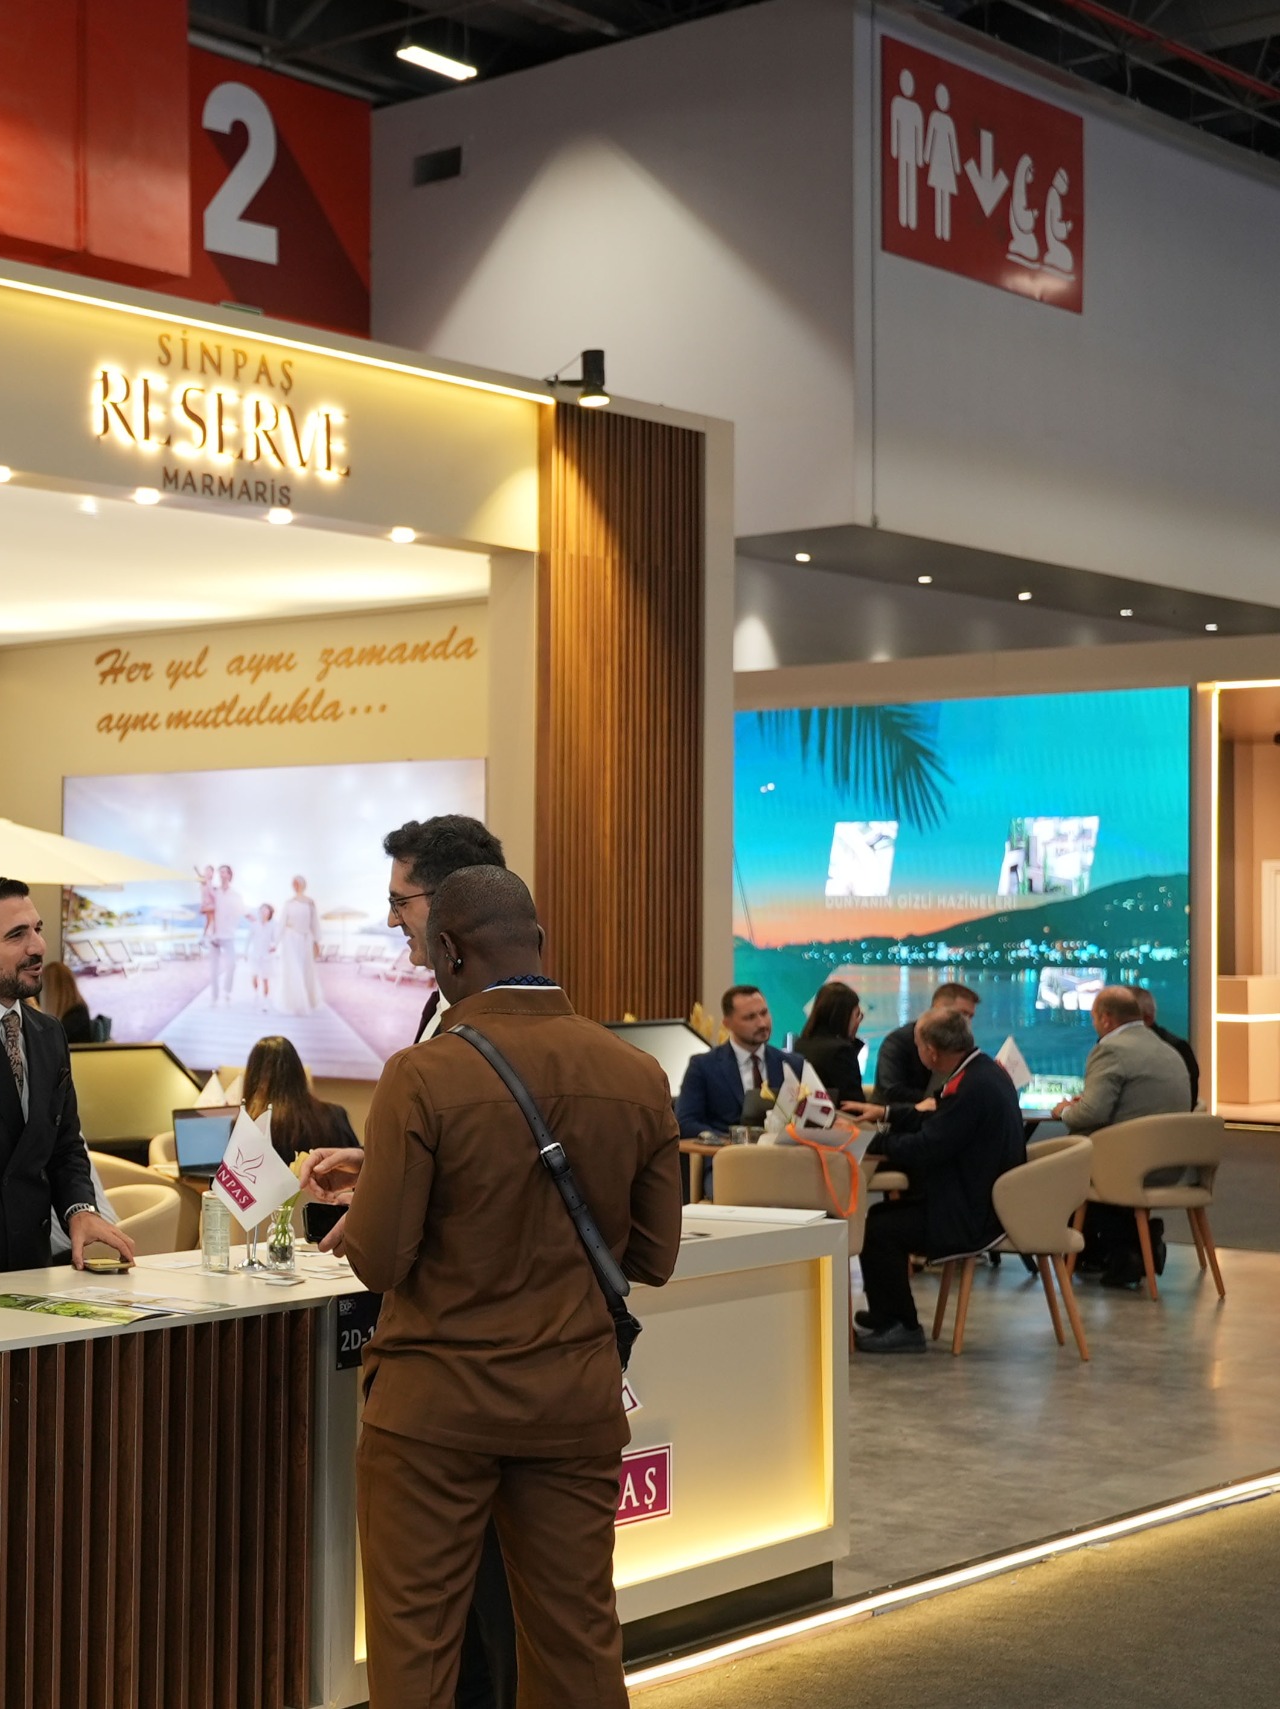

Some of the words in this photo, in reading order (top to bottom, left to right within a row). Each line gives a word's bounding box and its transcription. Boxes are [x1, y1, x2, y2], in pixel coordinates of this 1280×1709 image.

[201, 80, 278, 265] 2
[156, 330, 294, 396] SİNPAŞ
[95, 369, 351, 478] RESERVE
[95, 648, 153, 685] Her
[165, 645, 209, 690] yıl
[316, 625, 479, 682] zamanda
[341, 1326, 375, 1352] 2D-1
[618, 1467, 657, 1510] AŞ
